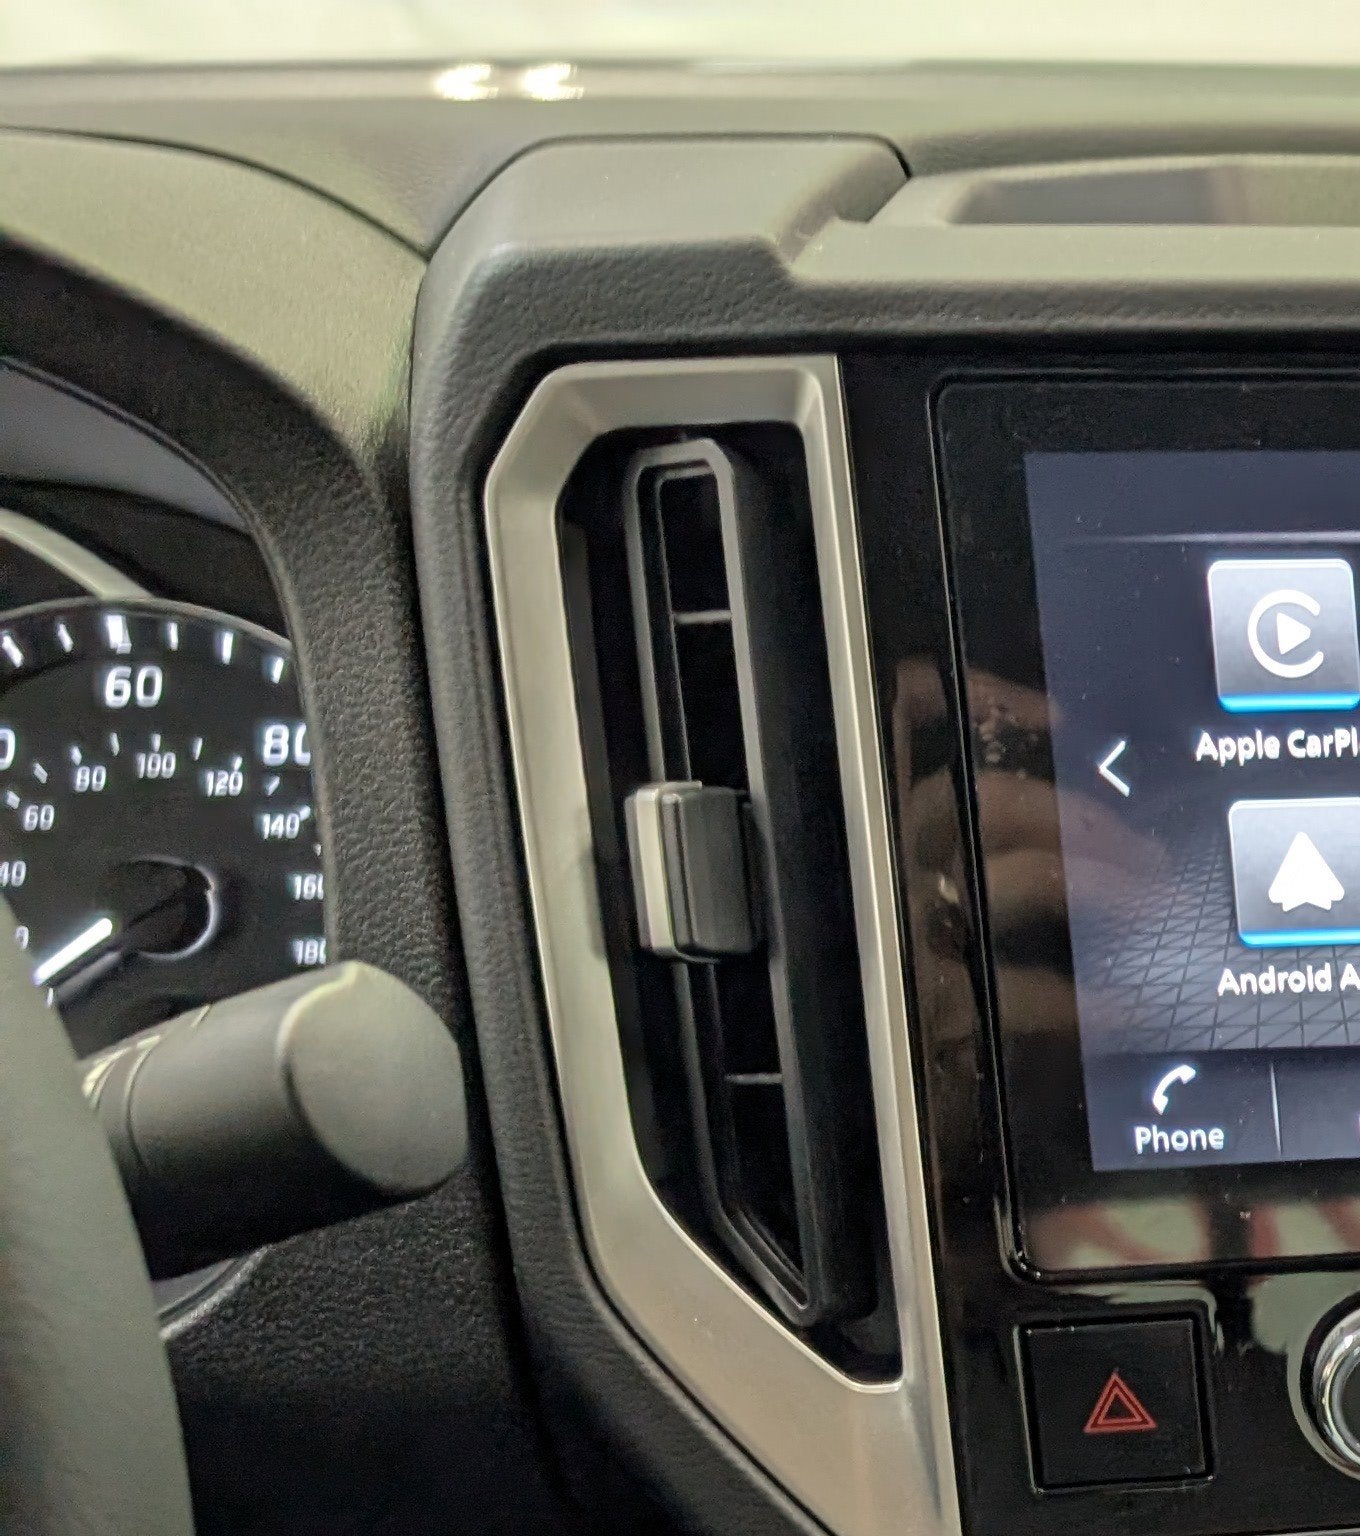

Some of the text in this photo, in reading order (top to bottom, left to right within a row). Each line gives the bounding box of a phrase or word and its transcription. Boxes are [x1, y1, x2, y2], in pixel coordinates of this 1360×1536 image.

[104, 665, 163, 708] 60
[1196, 731, 1280, 765] Apple
[74, 765, 107, 793] 80
[136, 752, 177, 778] 100
[205, 769, 244, 797] 120
[23, 804, 55, 831] 60
[261, 812, 300, 839] 140
[1217, 964, 1333, 997] Android
[1134, 1121, 1225, 1155] Phone
